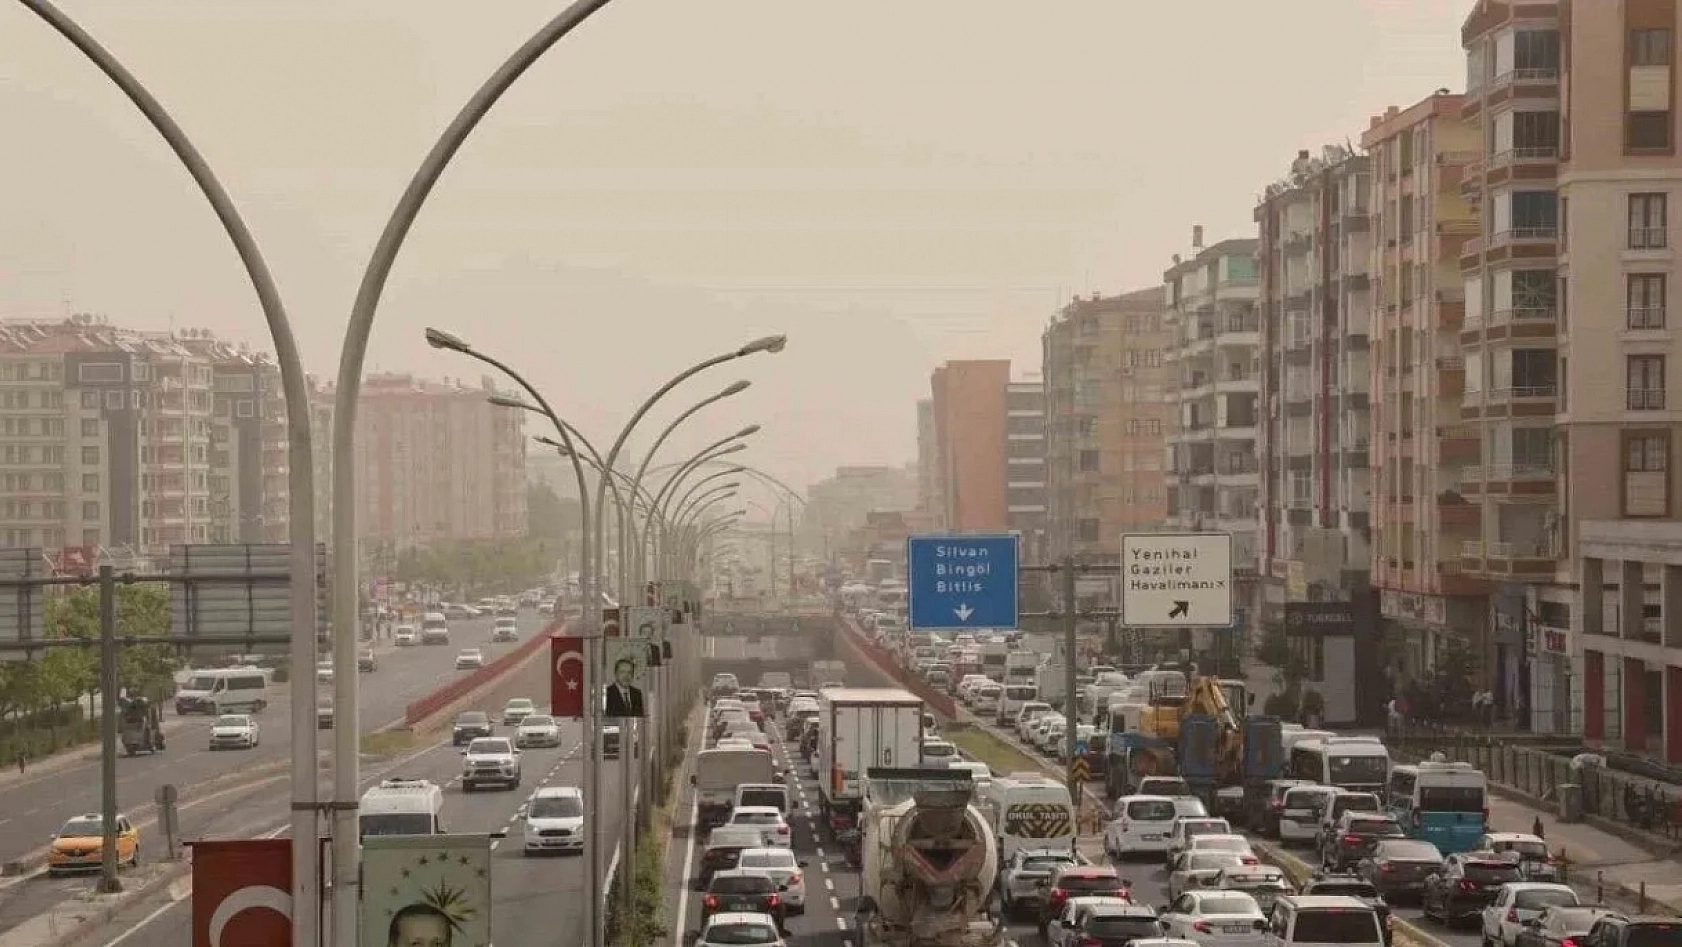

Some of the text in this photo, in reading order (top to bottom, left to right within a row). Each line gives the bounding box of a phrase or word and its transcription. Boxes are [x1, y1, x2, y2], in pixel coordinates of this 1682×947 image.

[936, 546, 989, 557] Silvan
[1130, 547, 1198, 560] Yenihal
[936, 561, 990, 577] Bingöl
[1130, 563, 1193, 575] Gaziler
[936, 580, 983, 592] Bitlis
